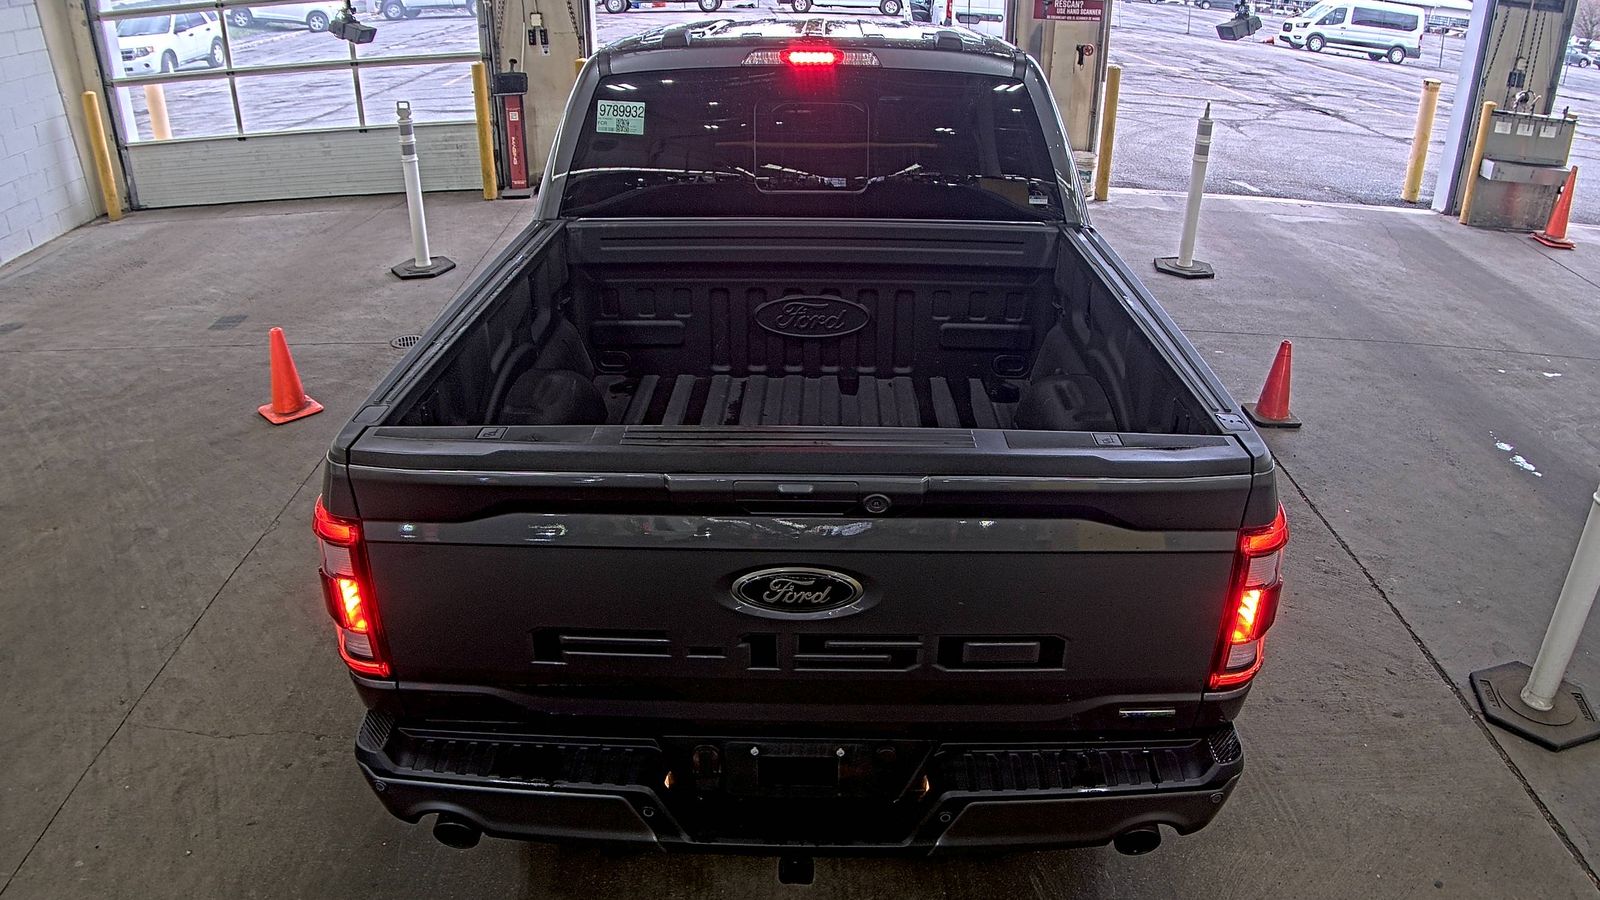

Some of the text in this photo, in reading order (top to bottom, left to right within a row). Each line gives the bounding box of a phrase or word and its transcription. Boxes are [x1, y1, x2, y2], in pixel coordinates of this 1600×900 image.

[1054, 0, 1084, 8] RESCAN?
[599, 103, 645, 118] 9789932
[775, 301, 847, 329] Ford
[763, 578, 832, 603] Ford
[529, 626, 1069, 672] F-150
